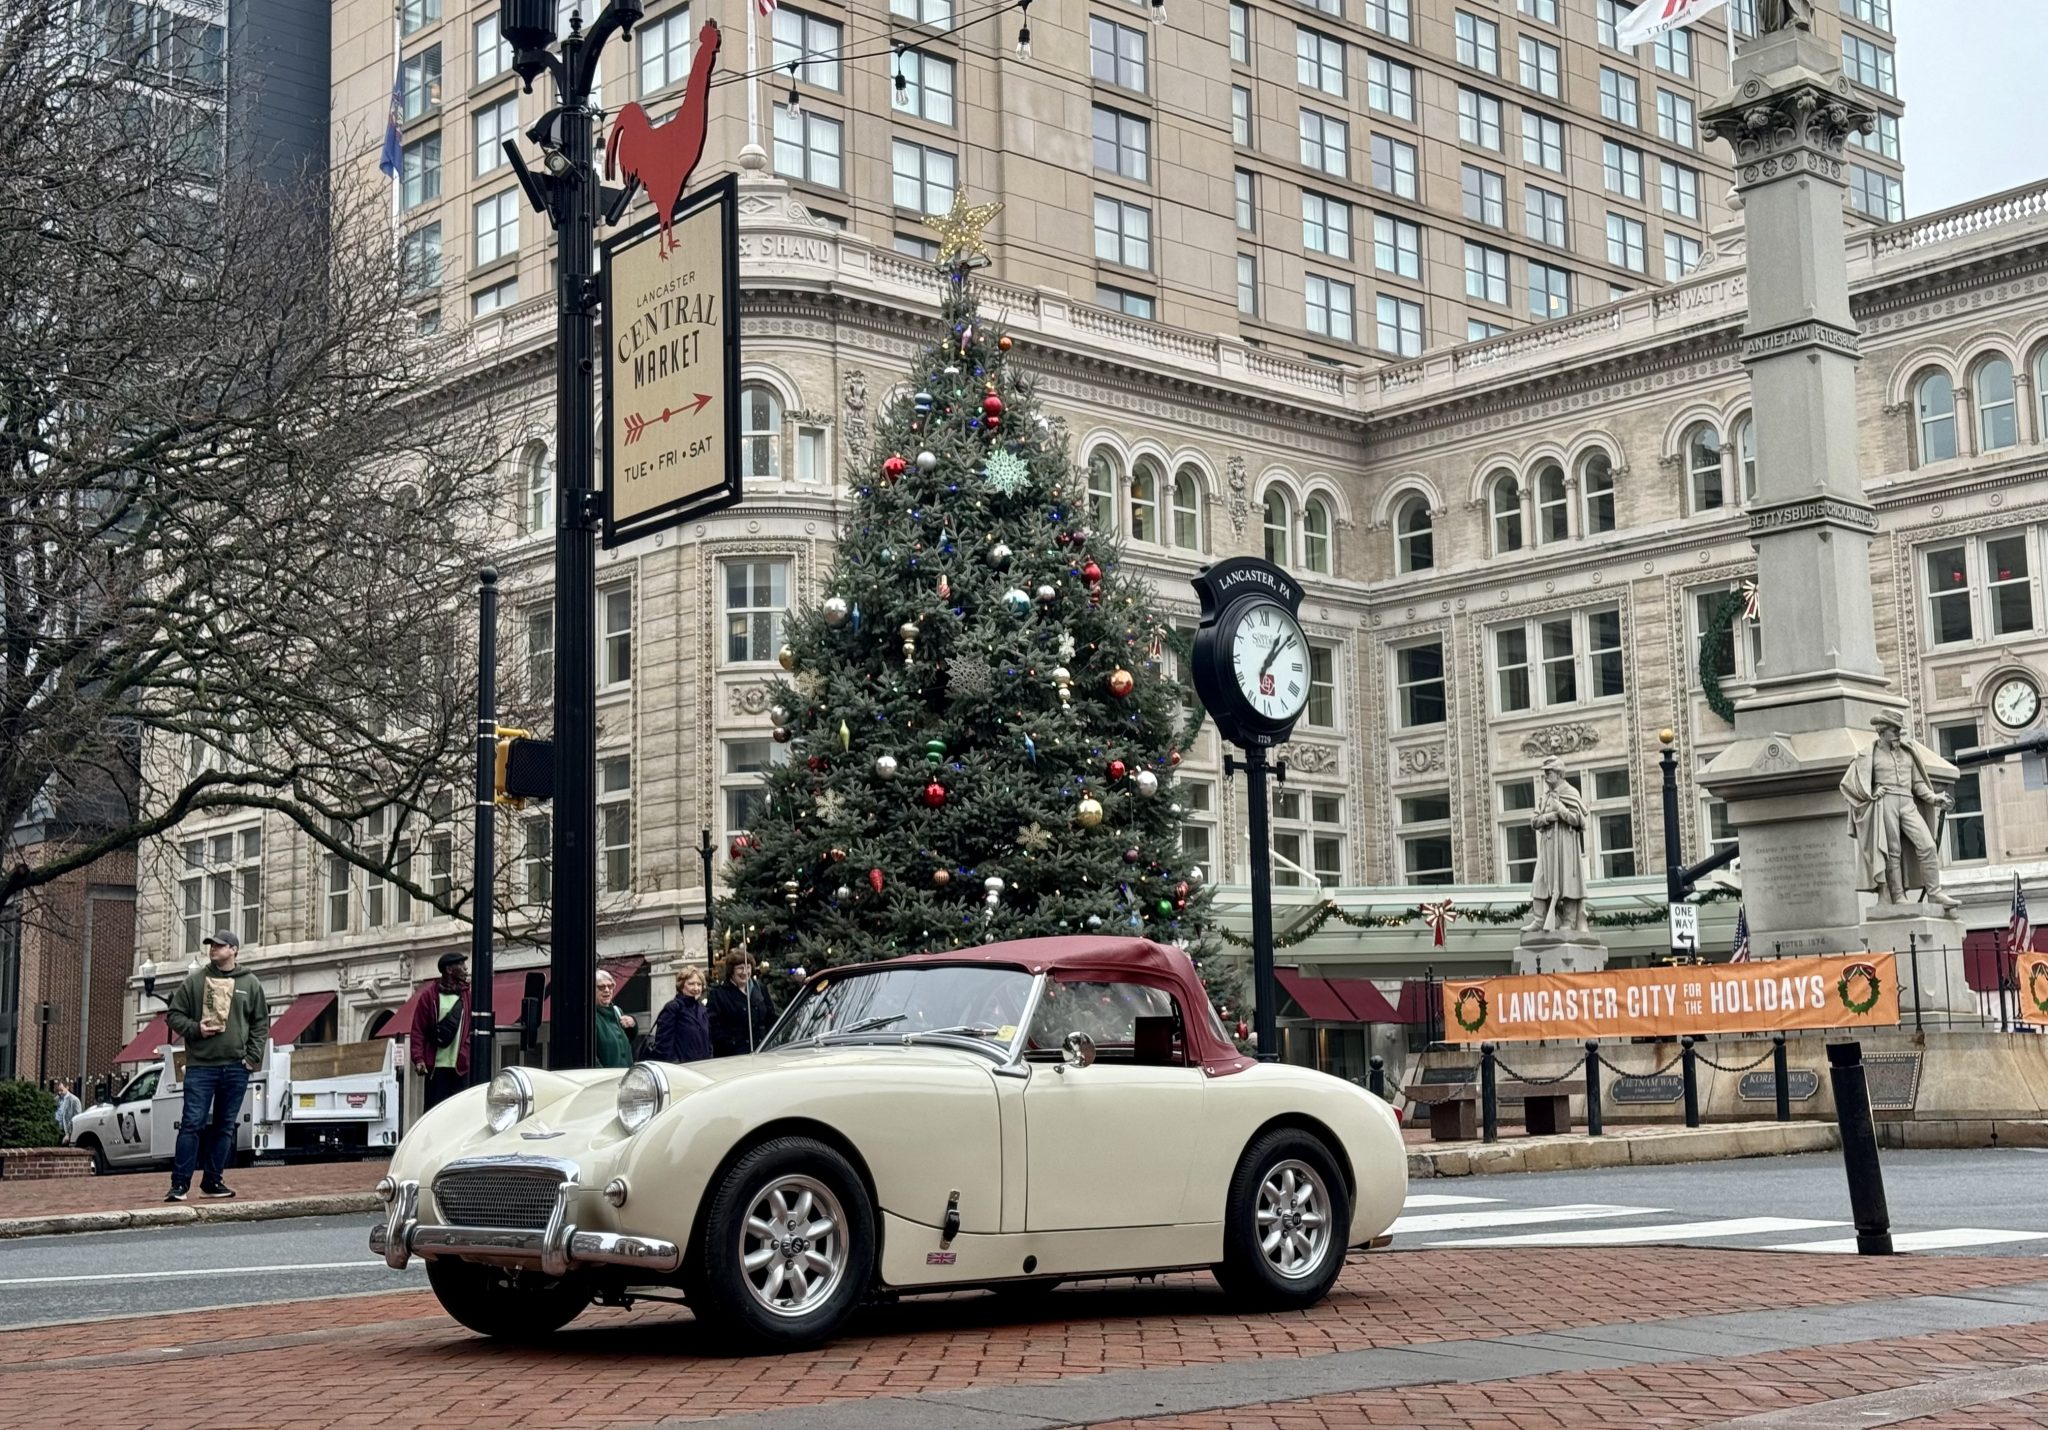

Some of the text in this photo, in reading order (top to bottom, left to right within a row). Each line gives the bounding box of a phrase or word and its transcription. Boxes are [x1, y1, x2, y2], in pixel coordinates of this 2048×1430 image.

[761, 236, 831, 264] SHAND
[636, 270, 696, 308] LANCASTER
[1681, 276, 1745, 309] WATT &
[617, 293, 718, 364] CENTRAL
[1748, 326, 1810, 354] ANTIETAM
[1814, 325, 1861, 350] PETERSBURG
[634, 329, 700, 390] MARKET
[624, 435, 713, 483] TUE FRI SAT
[1749, 502, 1825, 528] GETTYSBURG
[1219, 569, 1291, 600] LANCASTER, PA
[1257, 734, 1272, 745] 1729
[1674, 905, 1693, 917] ONE
[1674, 919, 1694, 929] WAY
[1771, 939, 1803, 949] EECTED
[1497, 975, 1826, 1024] LANCASTER CITY FOR THE HOLIDAYS
[1621, 1077, 1679, 1088] VIETNAM WAR
[1749, 1073, 1809, 1084] KORE WAR
